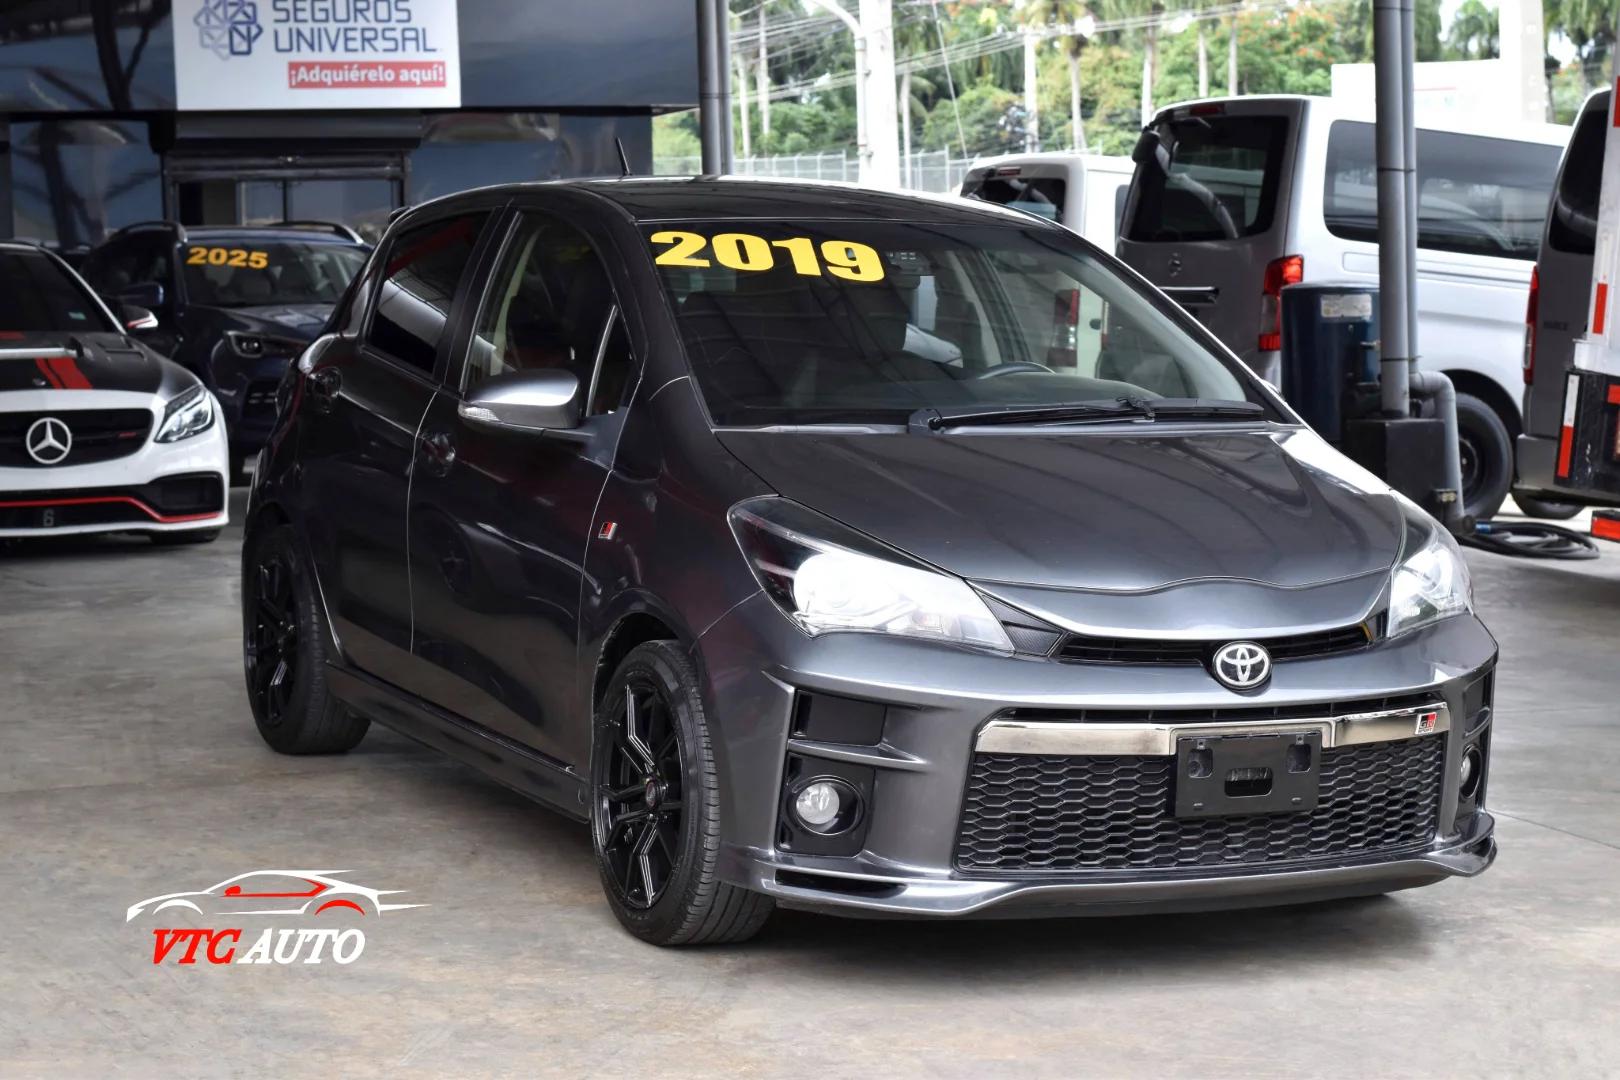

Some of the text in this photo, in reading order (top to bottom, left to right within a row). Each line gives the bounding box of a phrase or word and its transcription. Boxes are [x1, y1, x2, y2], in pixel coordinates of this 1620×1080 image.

[272, 0, 411, 23] SEGUROS
[273, 27, 437, 52] UNIVERSAL
[290, 64, 445, 84] ¡Adquiérelo aquí!
[187, 247, 268, 269] 2025
[650, 231, 885, 282] 2019
